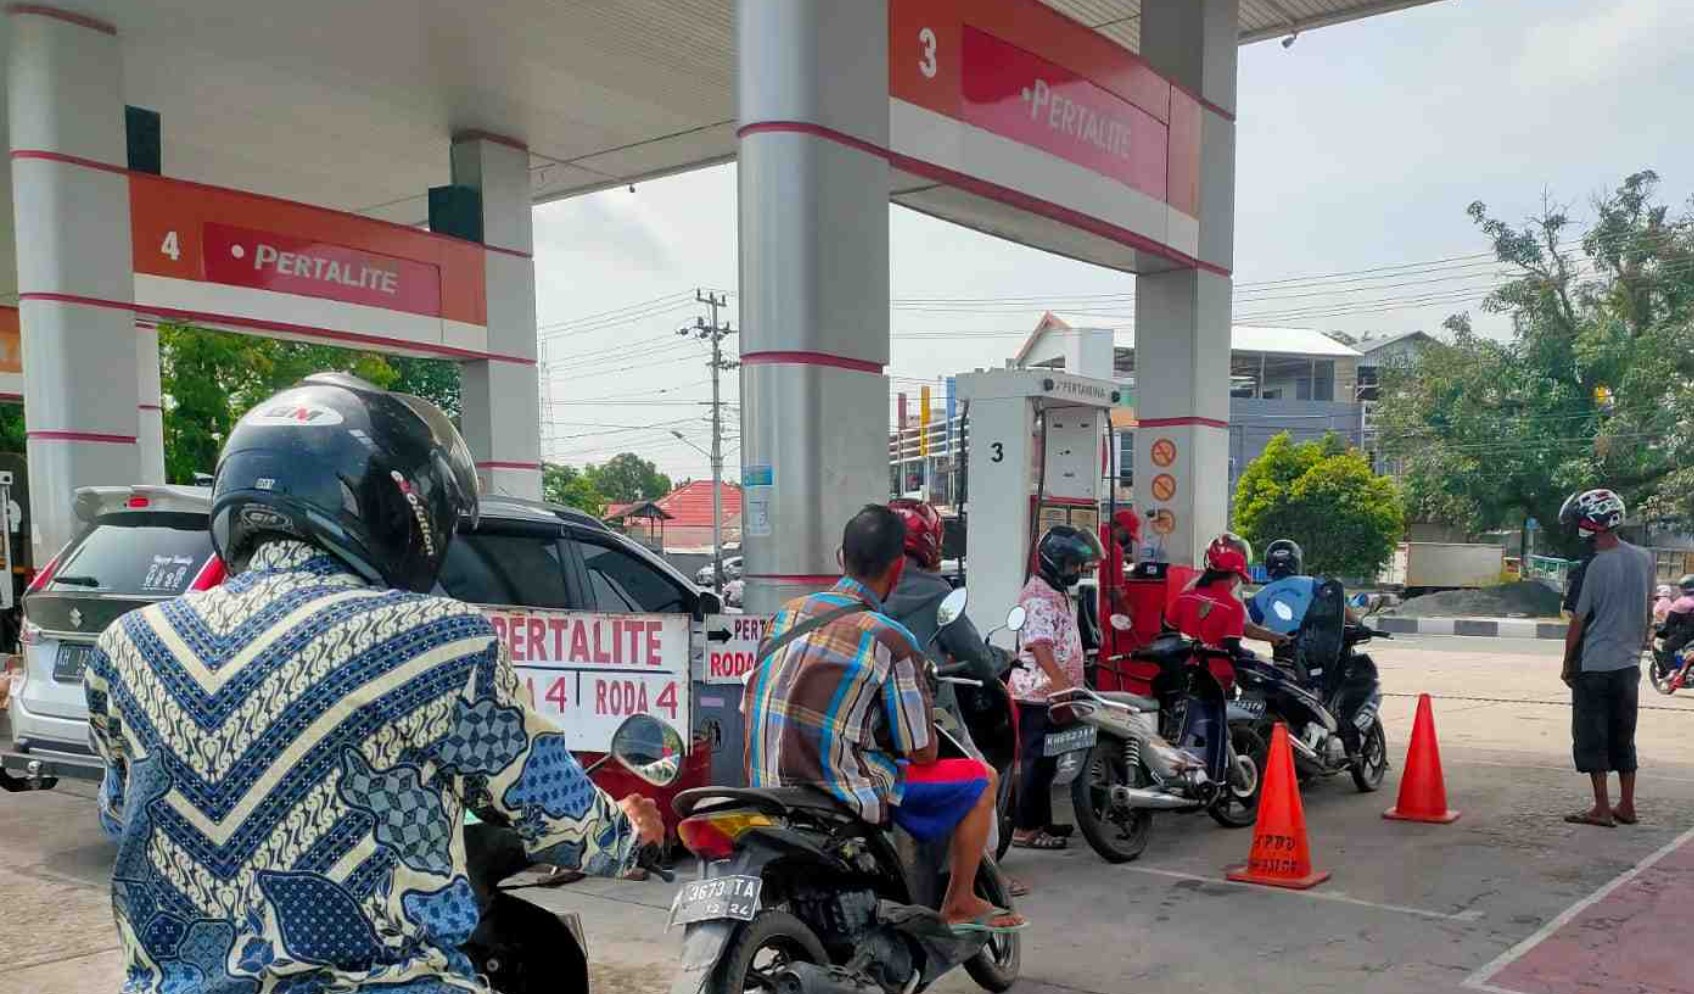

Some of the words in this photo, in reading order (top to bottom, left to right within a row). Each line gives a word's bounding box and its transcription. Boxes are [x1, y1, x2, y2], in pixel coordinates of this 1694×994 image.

[918, 27, 937, 78] 3
[1032, 78, 1132, 159] PERTALITE
[161, 230, 180, 261] 4
[253, 243, 399, 295] PERTALITE
[990, 442, 1004, 463] 3
[545, 676, 567, 714] 4
[595, 679, 649, 715] RODA
[655, 680, 678, 720] 4
[734, 879, 755, 898] TA
